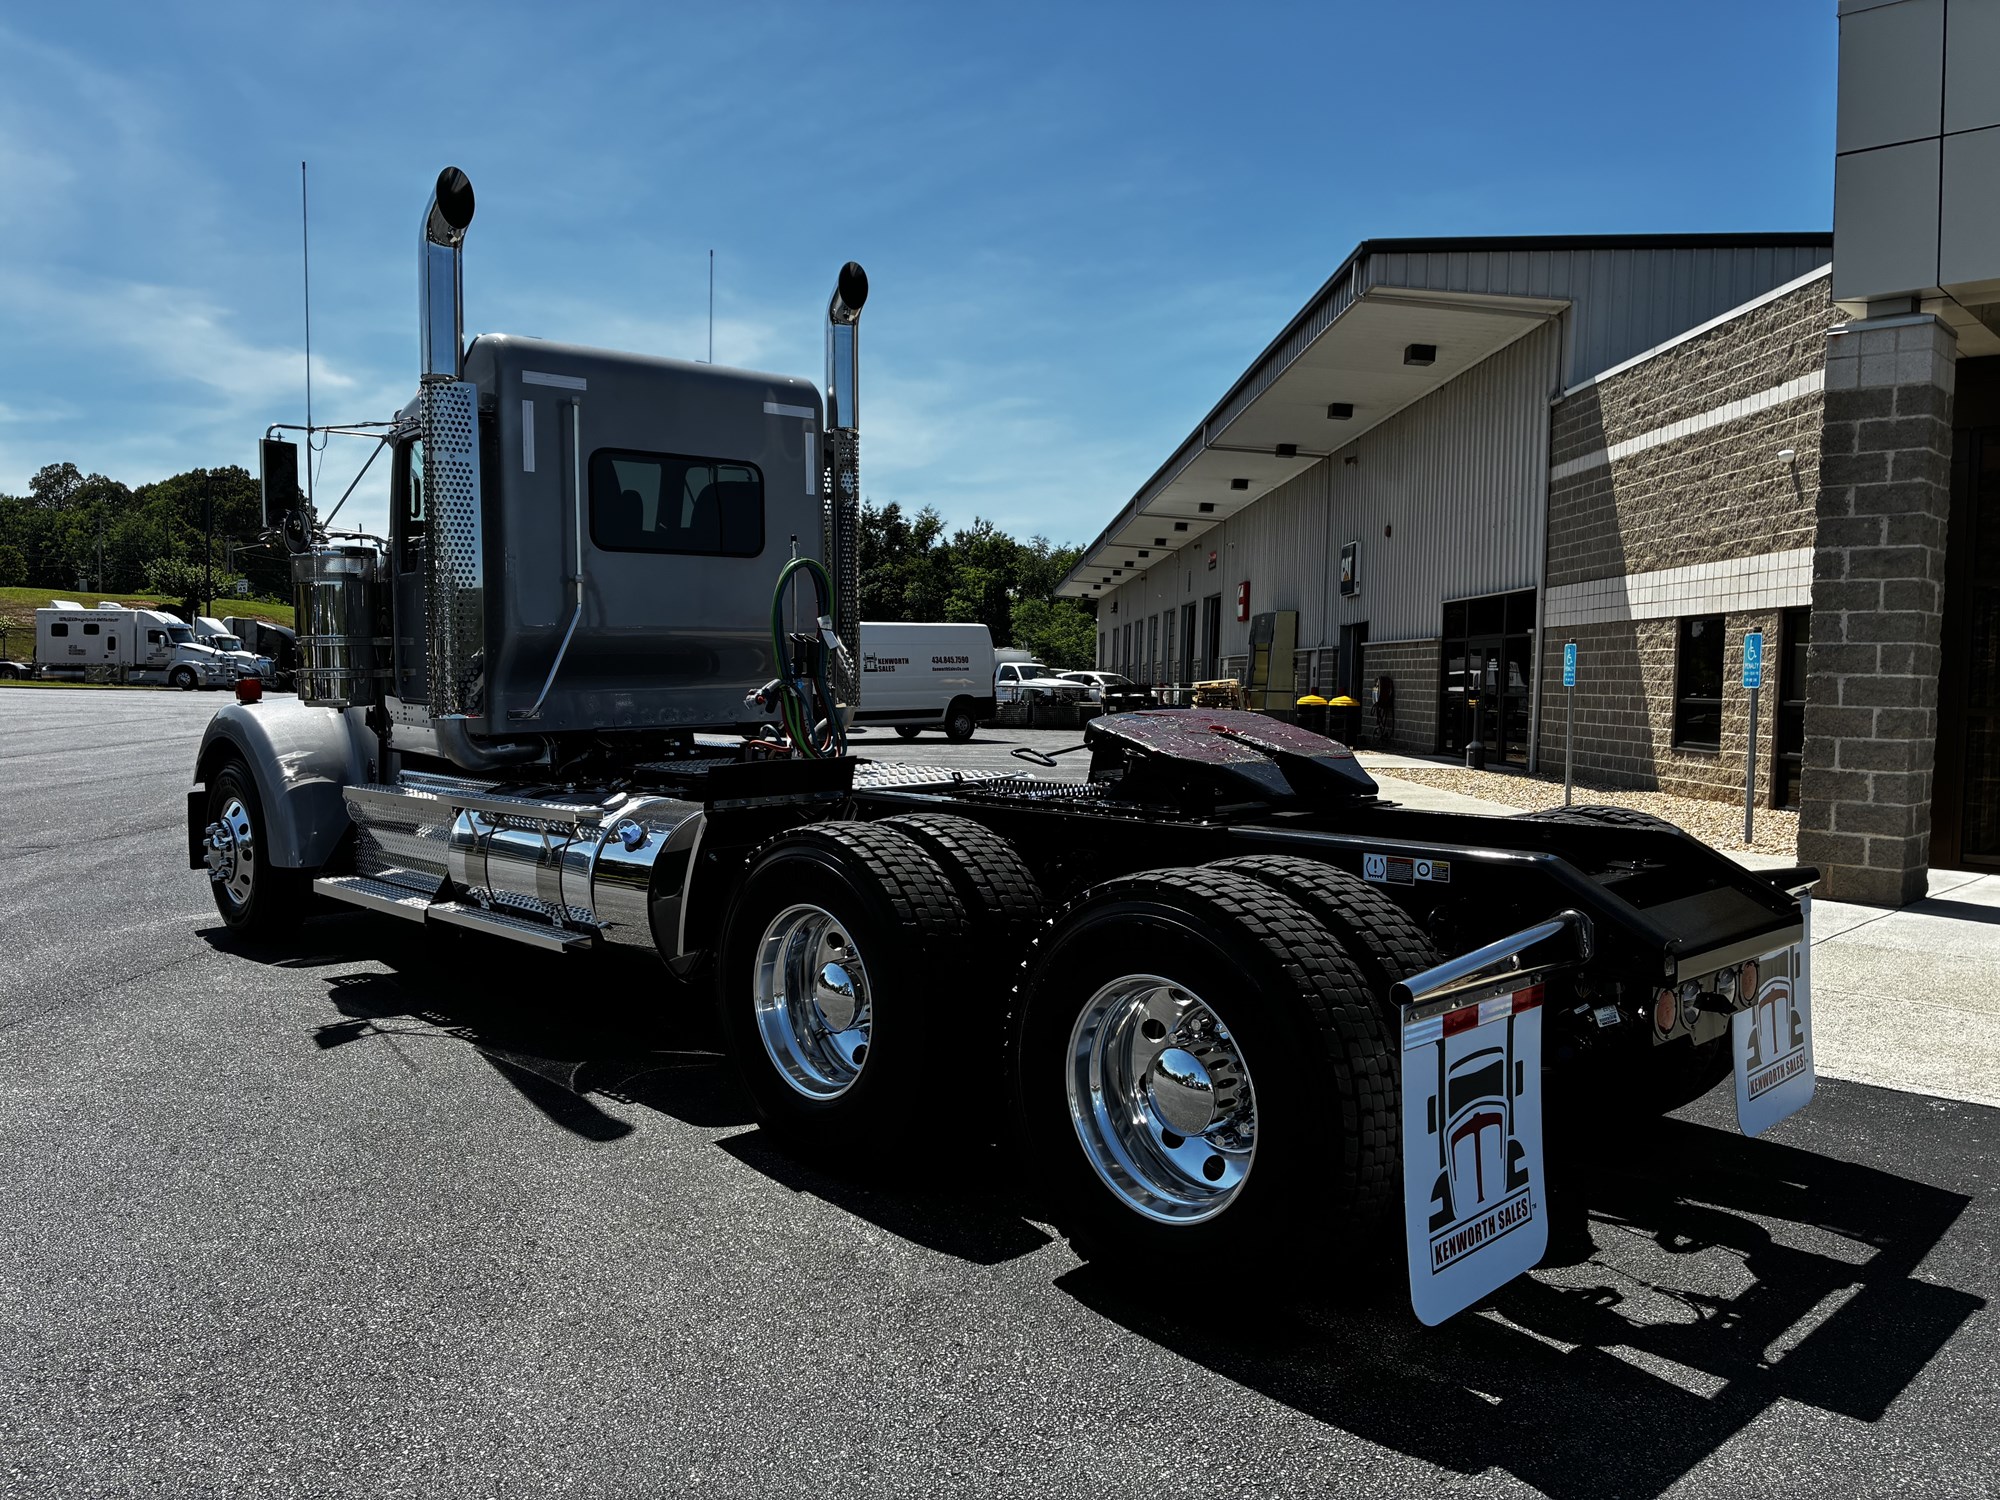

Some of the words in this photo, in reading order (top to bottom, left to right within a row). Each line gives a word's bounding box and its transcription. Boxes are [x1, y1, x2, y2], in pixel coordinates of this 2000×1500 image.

[1750, 1064, 1785, 1095] KENWORTH
[1786, 1054, 1804, 1076] SALES
[1434, 1215, 1496, 1265] KENWORTH
[1498, 1197, 1528, 1231] SALES
